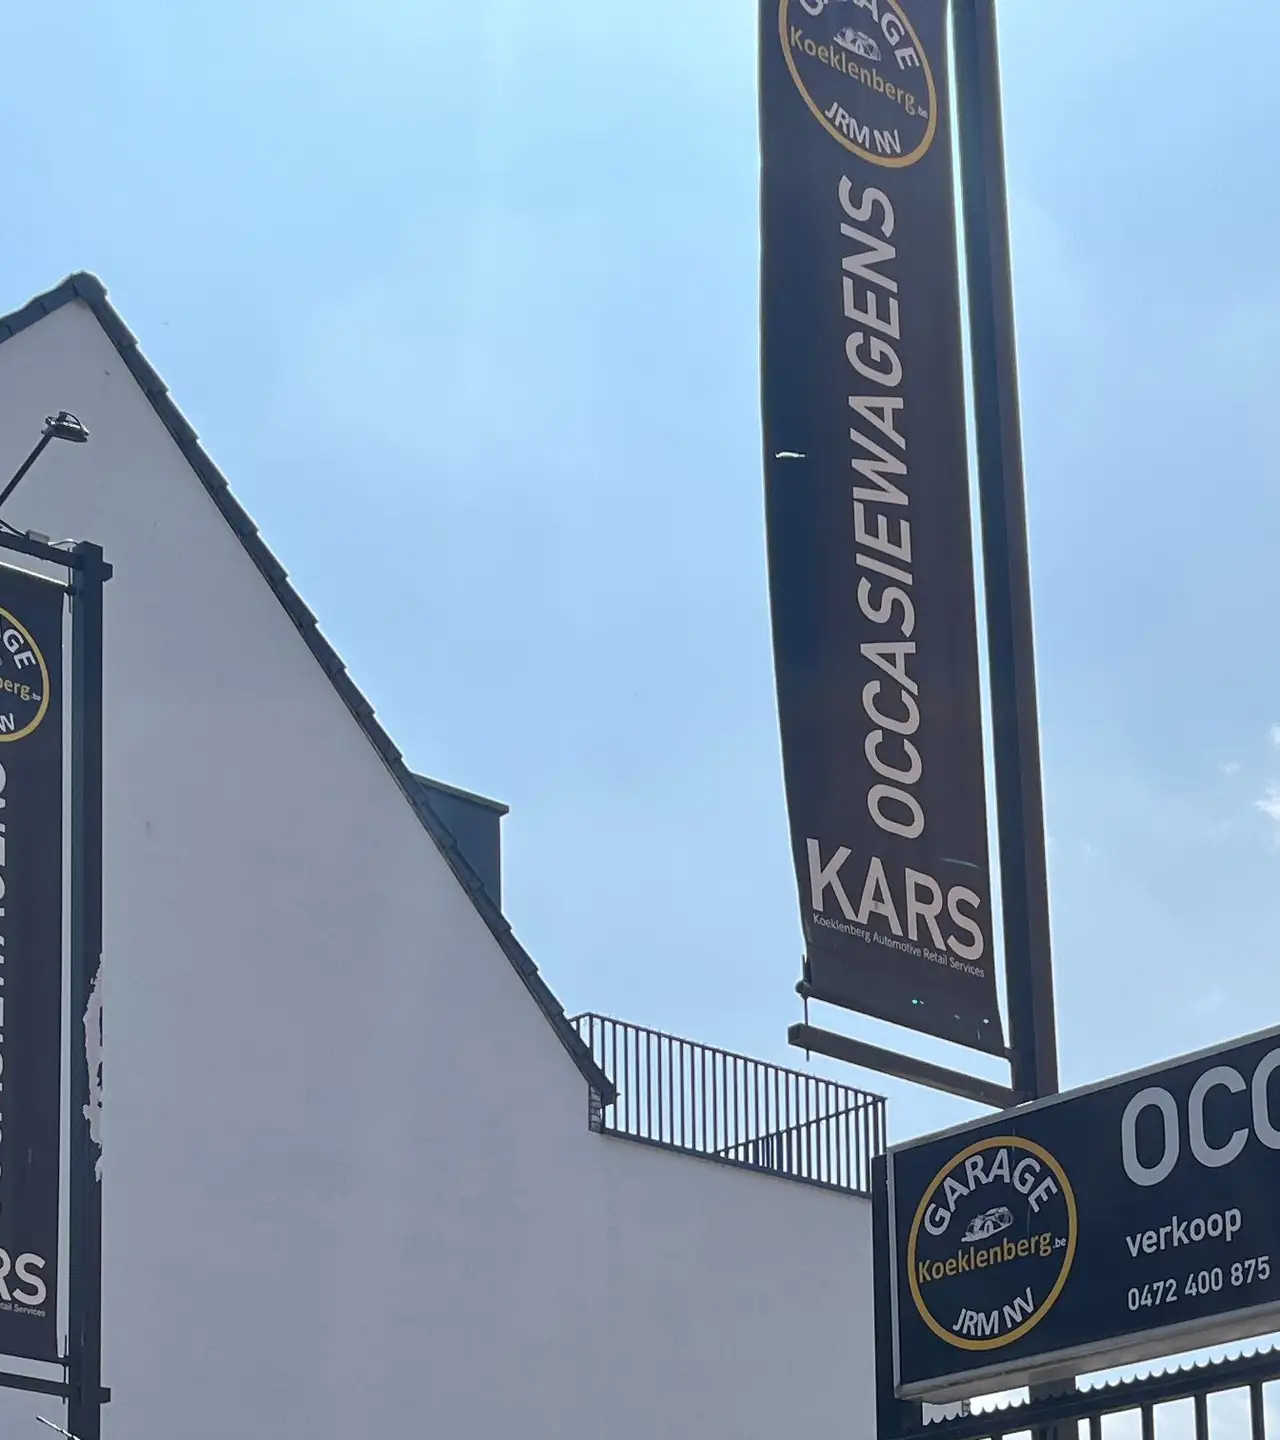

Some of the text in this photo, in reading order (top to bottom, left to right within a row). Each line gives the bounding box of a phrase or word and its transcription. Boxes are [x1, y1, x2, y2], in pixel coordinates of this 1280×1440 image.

[824, 101, 870, 149] JRM
[837, 174, 926, 840] OCCASIEWAGENS
[806, 837, 985, 961] KARS
[812, 912, 985, 979] Koeklenberg Automotive Retail Services
[923, 1148, 1059, 1236] GARAGE
[1125, 1207, 1242, 1257] verkoop
[13, 1303, 46, 1318] Services
[1127, 1278, 1178, 1312] 0472
[1184, 1267, 1223, 1297] 400
[1230, 1255, 1271, 1287] 875
[952, 1307, 1000, 1337] JRM
